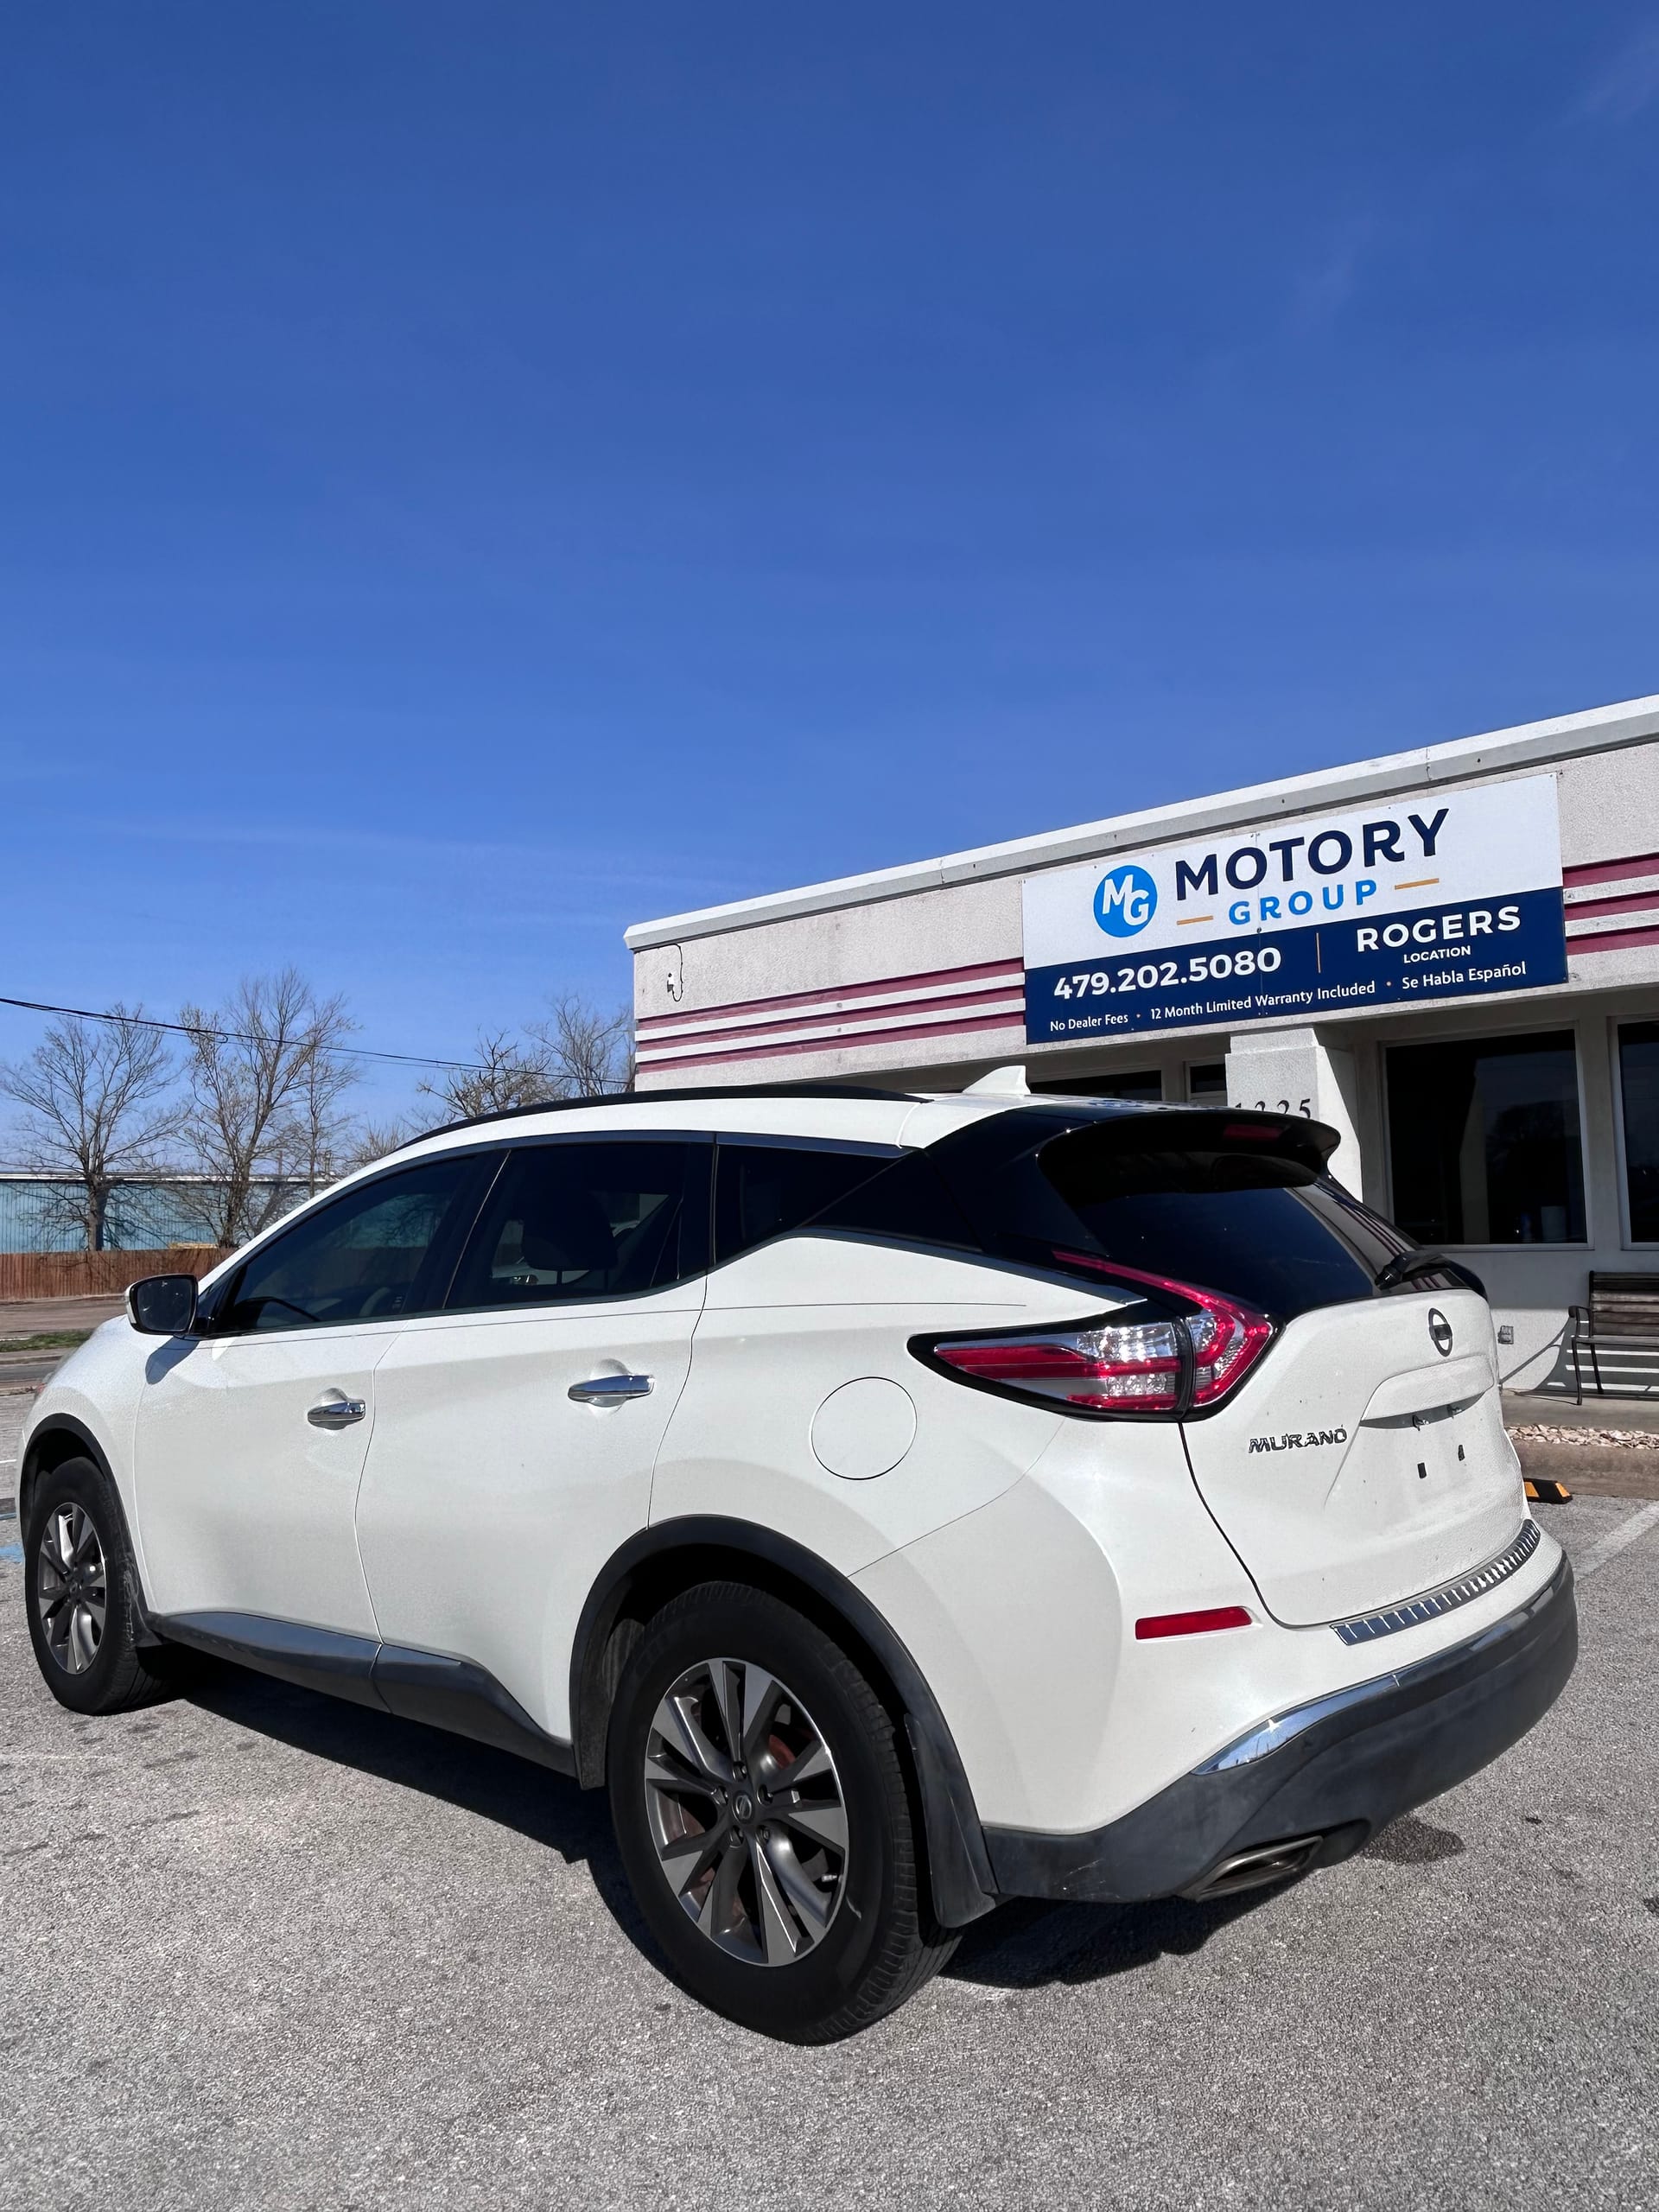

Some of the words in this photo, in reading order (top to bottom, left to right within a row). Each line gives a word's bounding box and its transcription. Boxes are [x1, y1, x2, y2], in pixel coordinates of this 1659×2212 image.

[1175, 809, 1449, 900] MOTORY
[1102, 874, 1149, 925] MG
[1229, 880, 1377, 925] GROUP
[1357, 906, 1522, 952] ROGERS
[1053, 947, 1281, 1000] 479.202.5080
[1403, 945, 1471, 963] LOCATION
[1050, 1020, 1065, 1031] No
[1068, 1016, 1102, 1030] Dealer
[1104, 1014, 1128, 1026] Fees
[1150, 1008, 1161, 1020] 12
[1165, 1003, 1203, 1019] Month
[1206, 998, 1252, 1014] Limited
[1255, 991, 1313, 1011] Warranty
[1317, 981, 1376, 1000] Included
[1402, 977, 1419, 989] Se
[1422, 969, 1465, 987] Habla
[1468, 961, 1527, 982] Español
[1249, 1428, 1348, 1453] MURANO
